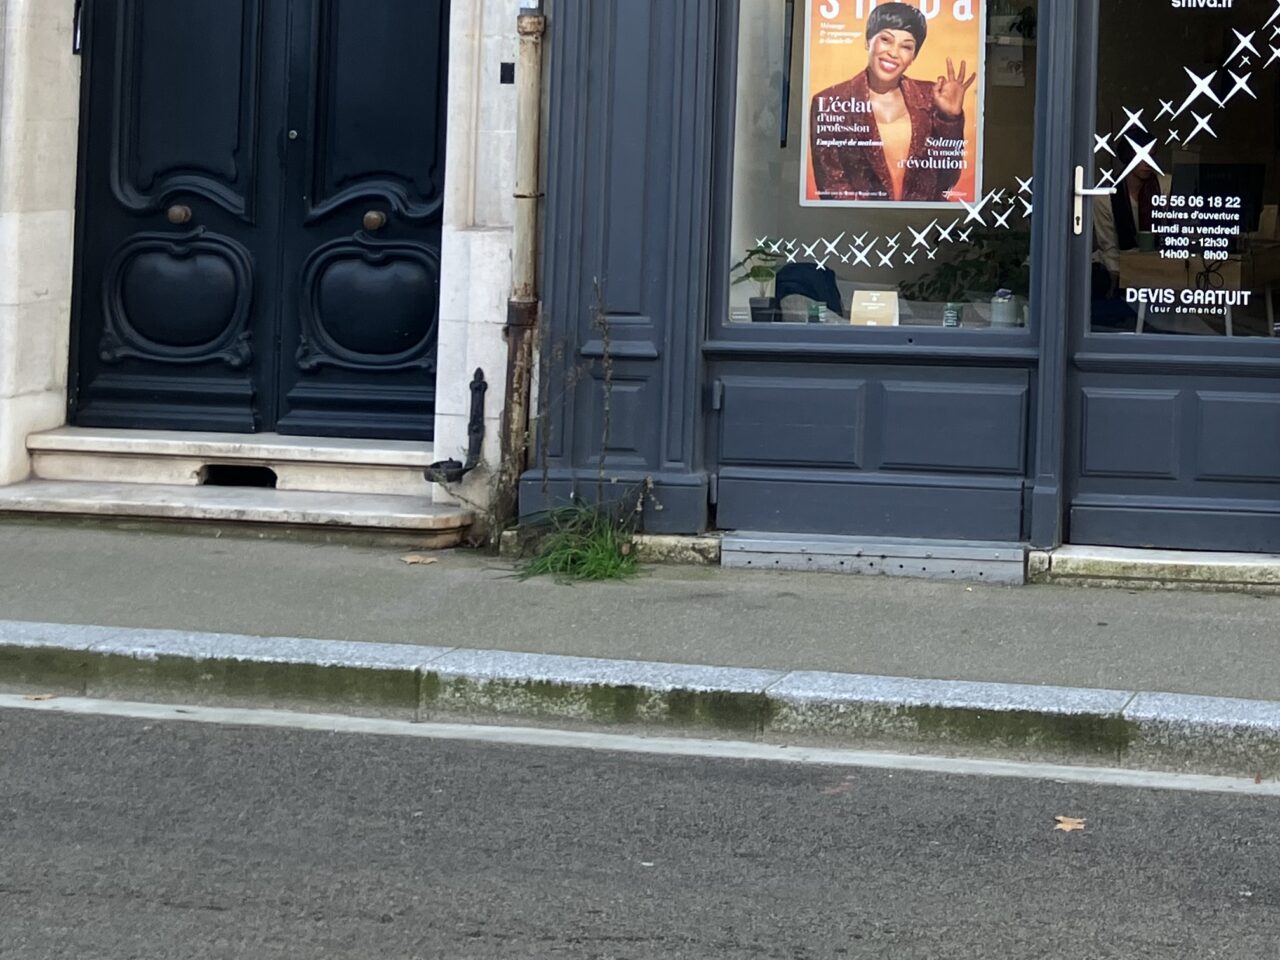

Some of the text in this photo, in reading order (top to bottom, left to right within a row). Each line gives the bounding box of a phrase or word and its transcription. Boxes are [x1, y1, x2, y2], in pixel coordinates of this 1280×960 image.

[816, 123, 870, 134] profession
[924, 136, 969, 150] Solange
[1151, 195, 1241, 208] 05 56 06 18 22
[1151, 210, 1240, 221] Horaires d'ouverture
[1151, 223, 1240, 235] Lundi au vendredi
[1164, 236, 1190, 246] 9h00
[1199, 237, 1229, 248] 12h30
[1159, 249, 1190, 259] 14h00
[1126, 287, 1252, 306] DEVIS GRATUIT
